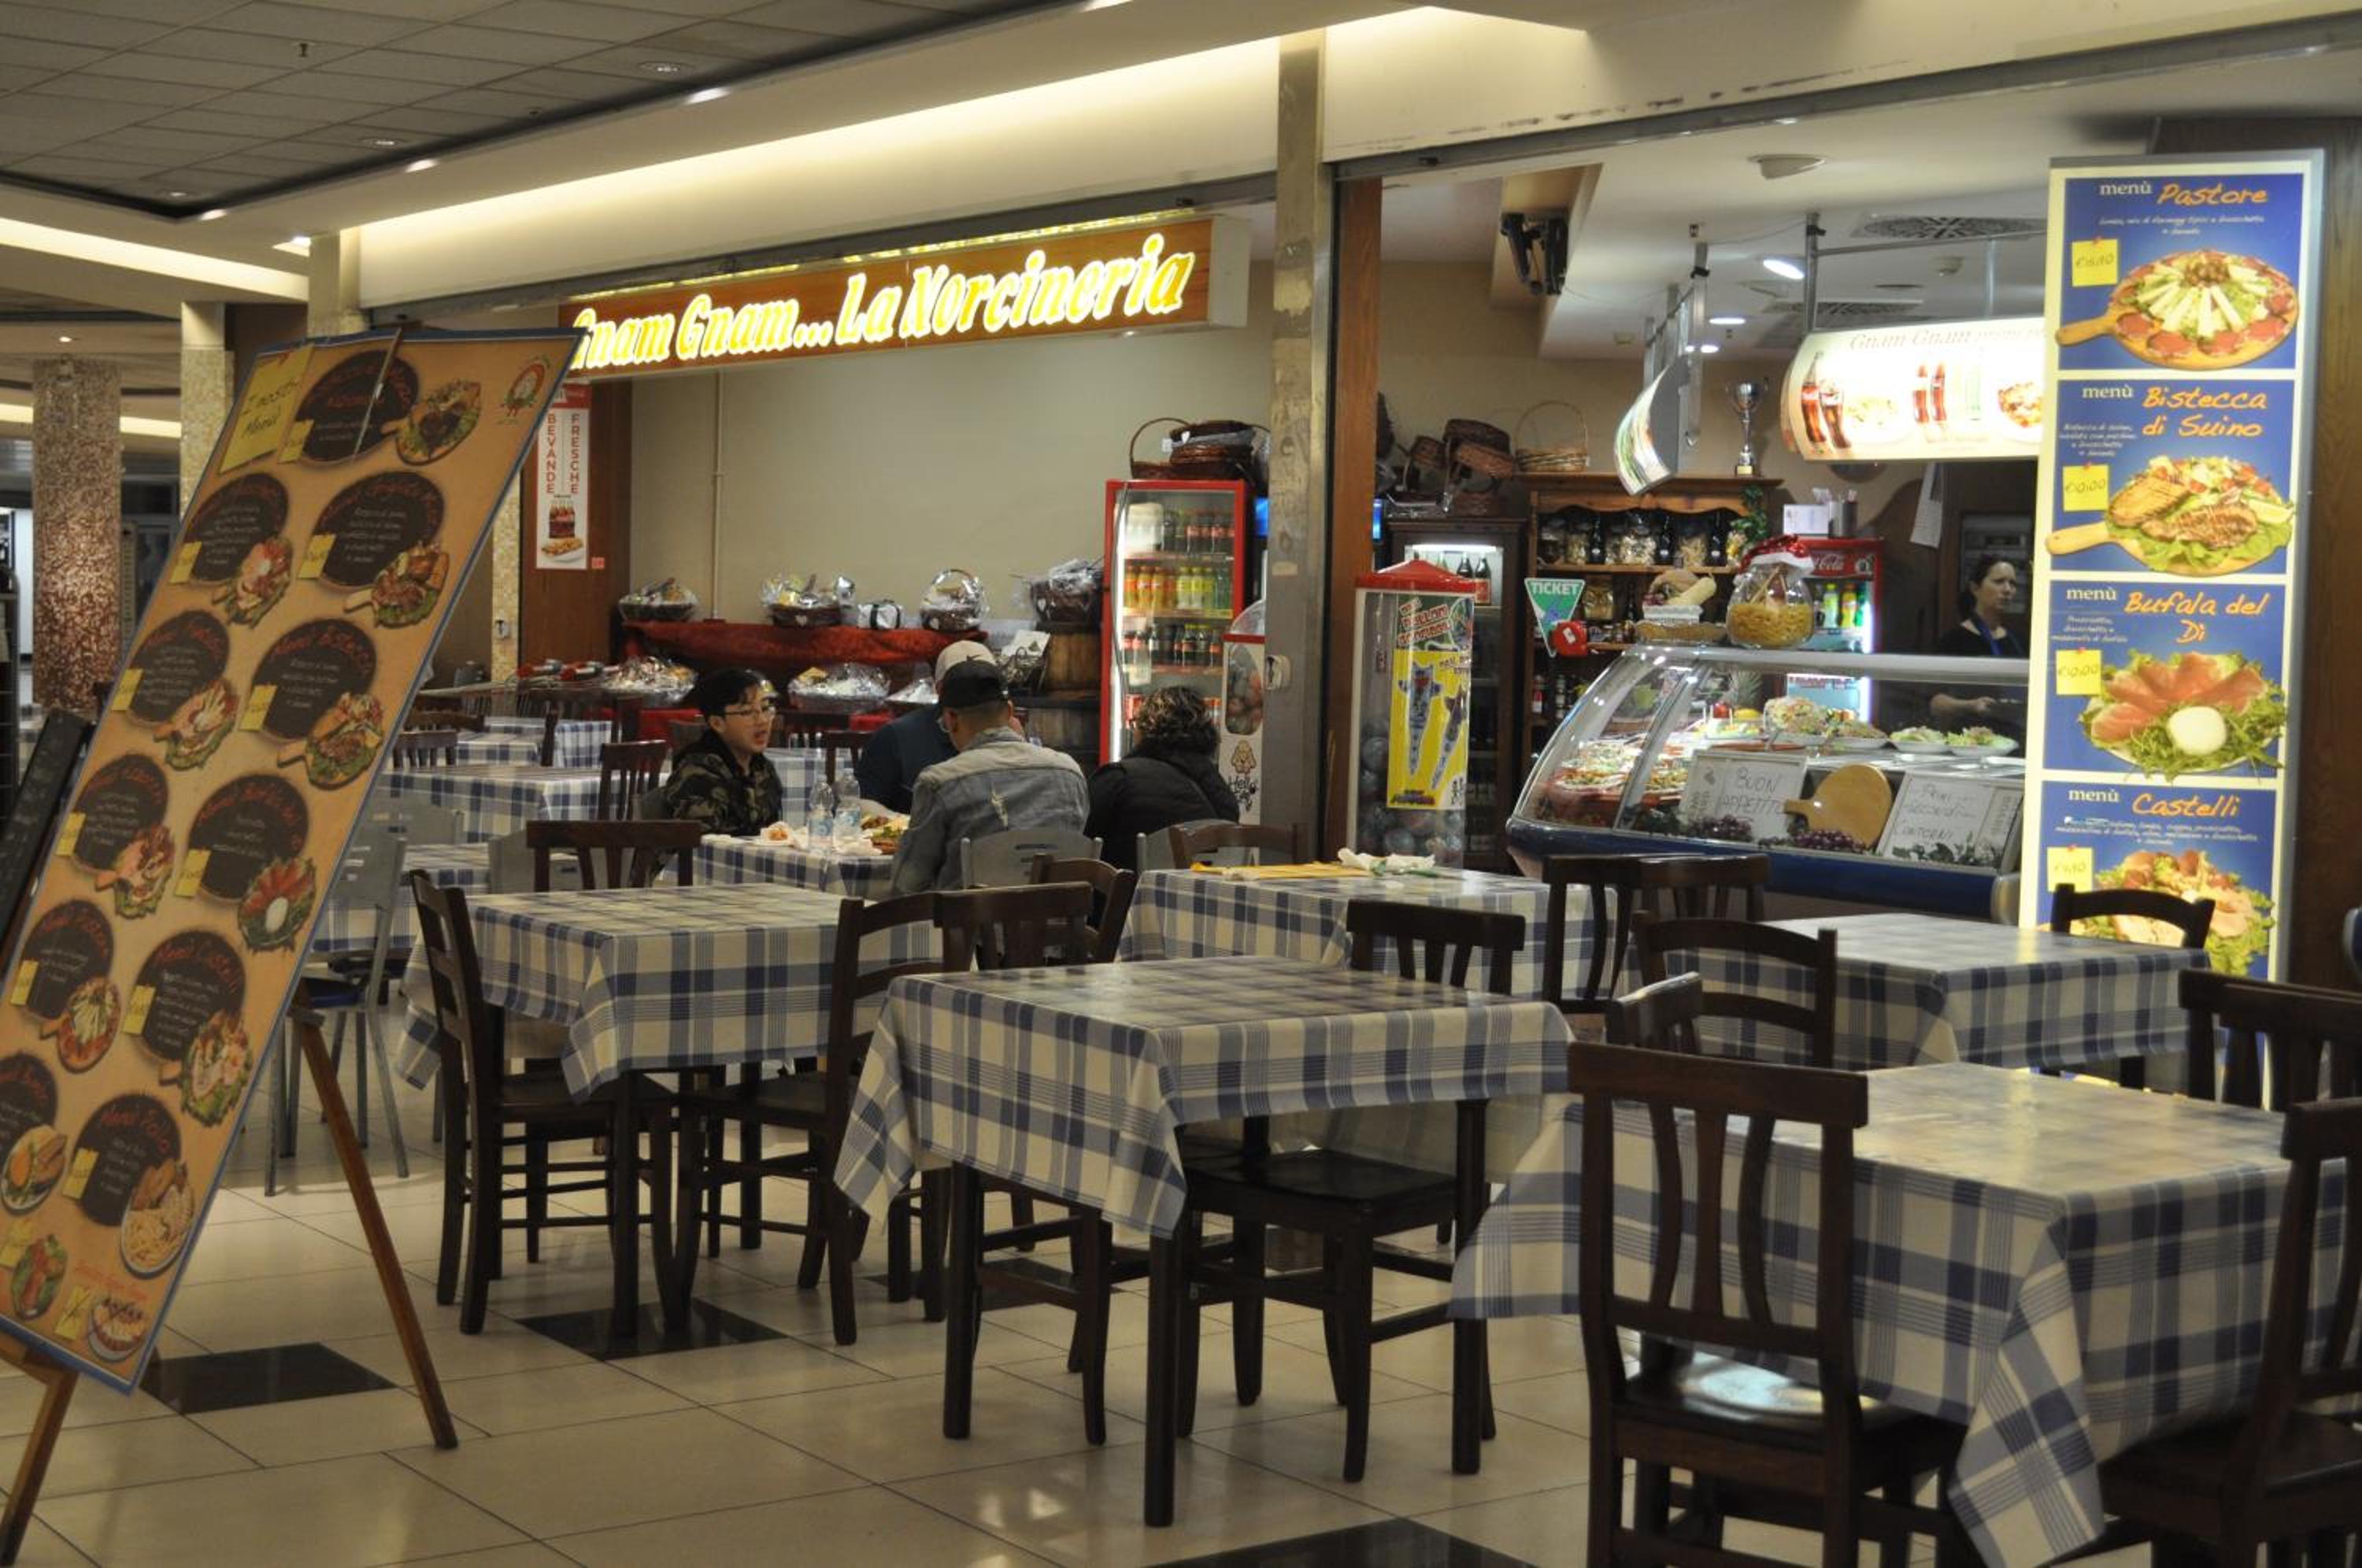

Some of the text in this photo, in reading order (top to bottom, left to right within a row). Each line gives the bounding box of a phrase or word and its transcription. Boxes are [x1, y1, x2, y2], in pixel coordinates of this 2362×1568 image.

[2100, 180, 2268, 205] menù Pastore
[676, 294, 833, 361] Gnam...
[835, 272, 902, 345] La
[900, 233, 1195, 338] Norcineria
[2081, 384, 2268, 410] menù Bistecca
[2142, 413, 2263, 438] di Suino
[546, 413, 556, 494] BEVANDE
[570, 413, 580, 494] FRESCHE
[1531, 582, 1579, 596] TICKET
[2066, 586, 2271, 616] menù Bufala del
[2068, 787, 2241, 818] menù Castelli
